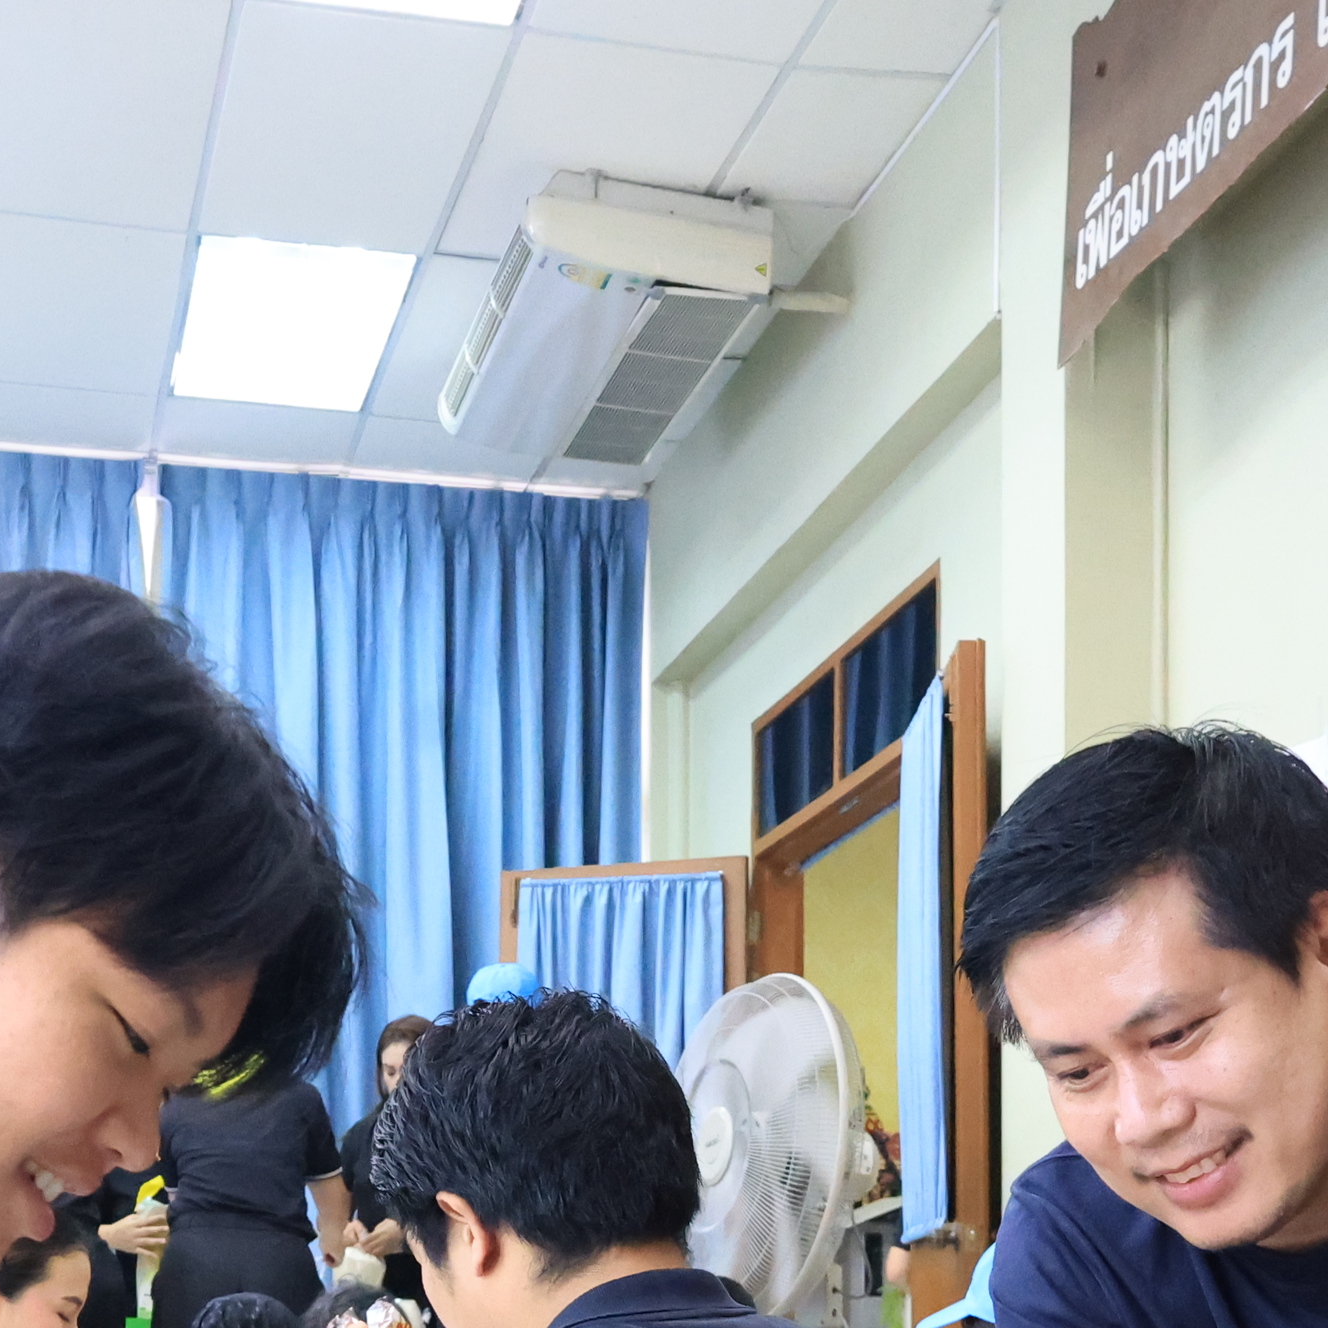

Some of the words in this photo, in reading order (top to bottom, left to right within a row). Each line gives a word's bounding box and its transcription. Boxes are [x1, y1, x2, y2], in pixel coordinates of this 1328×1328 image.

[1074, 12, 1296, 291] เพื่อเกษตรกร
